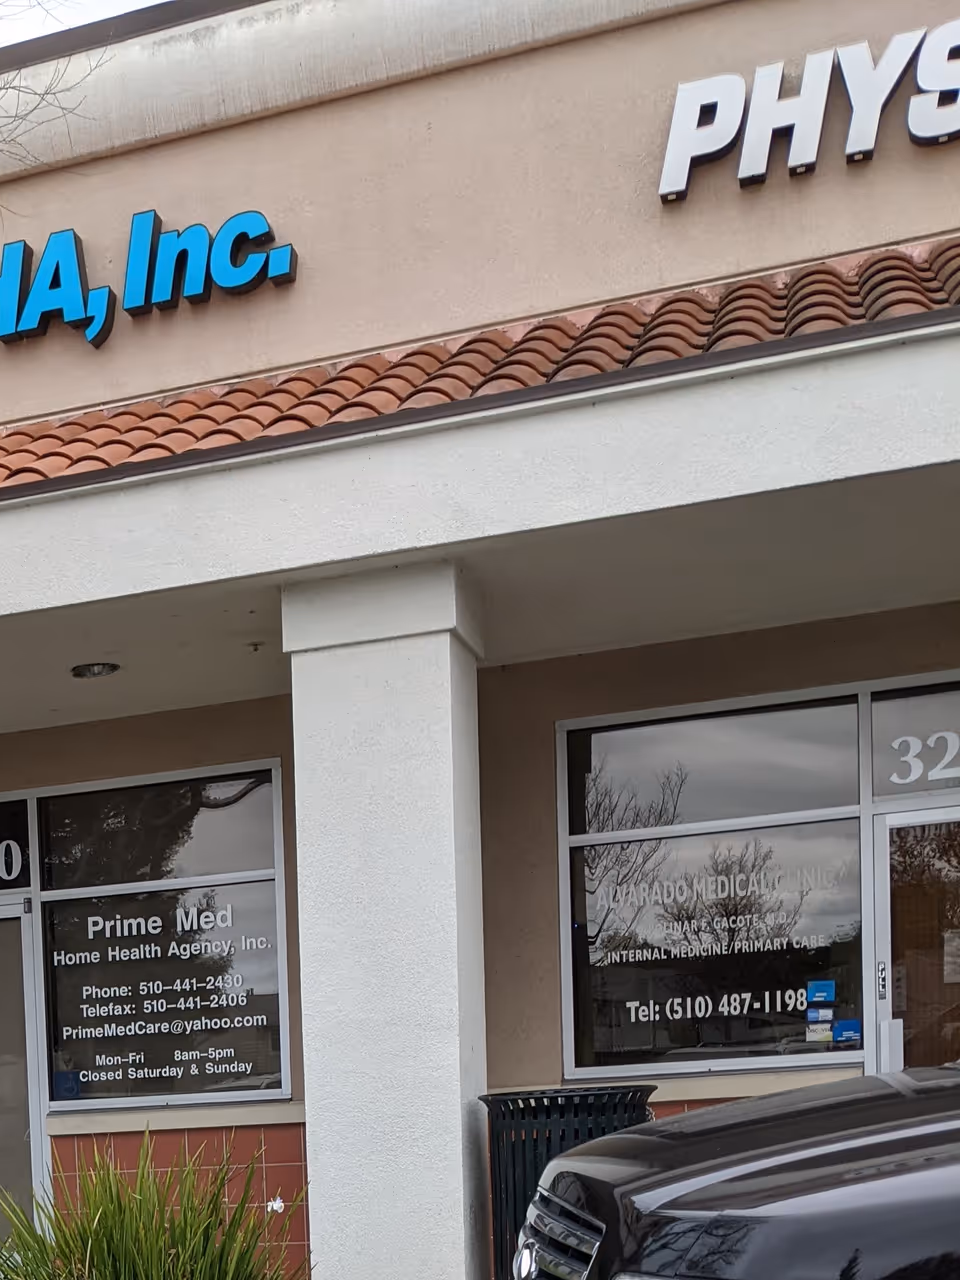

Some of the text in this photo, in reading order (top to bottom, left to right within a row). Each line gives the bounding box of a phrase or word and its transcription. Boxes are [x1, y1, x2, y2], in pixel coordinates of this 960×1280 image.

[123, 209, 296, 315] Inc.
[596, 880, 689, 910] ALVARADO
[692, 872, 772, 900] MEDICAL
[87, 904, 233, 939] Prime Med
[53, 935, 272, 966] Home Health Agency, Inc.
[607, 934, 825, 964] INTERNAL MEDICINE/PRIMARY CARE
[82, 985, 132, 1000] Phone:
[626, 988, 808, 1022] Tel: (510) 487-1198
[80, 1002, 136, 1018] Telefax:
[62, 1014, 267, 1040] PrimeMedCare@yahoo.com
[79, 1061, 253, 1082] Closed Saturday & Sunday
